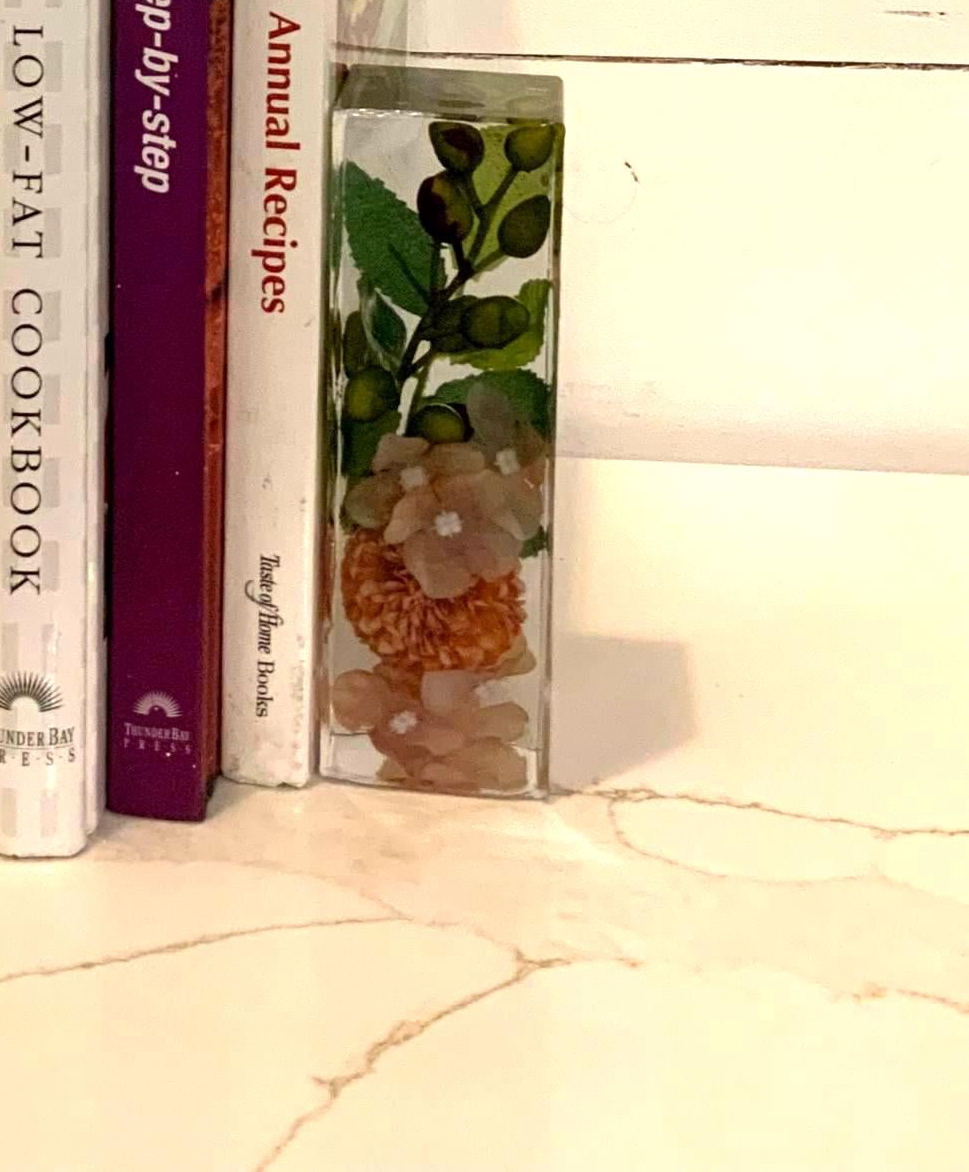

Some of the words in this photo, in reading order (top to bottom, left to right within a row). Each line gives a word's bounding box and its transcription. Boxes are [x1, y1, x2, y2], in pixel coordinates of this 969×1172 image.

[264, 11, 302, 151] Annual
[11, 24, 46, 259] LOW-FAT
[251, 167, 299, 314] Recipes
[9, 288, 44, 596] COOKBOOK
[258, 553, 281, 593] Taste
[257, 606, 284, 655] Home
[48, 726, 75, 747] BAY
[255, 660, 276, 719] Books
